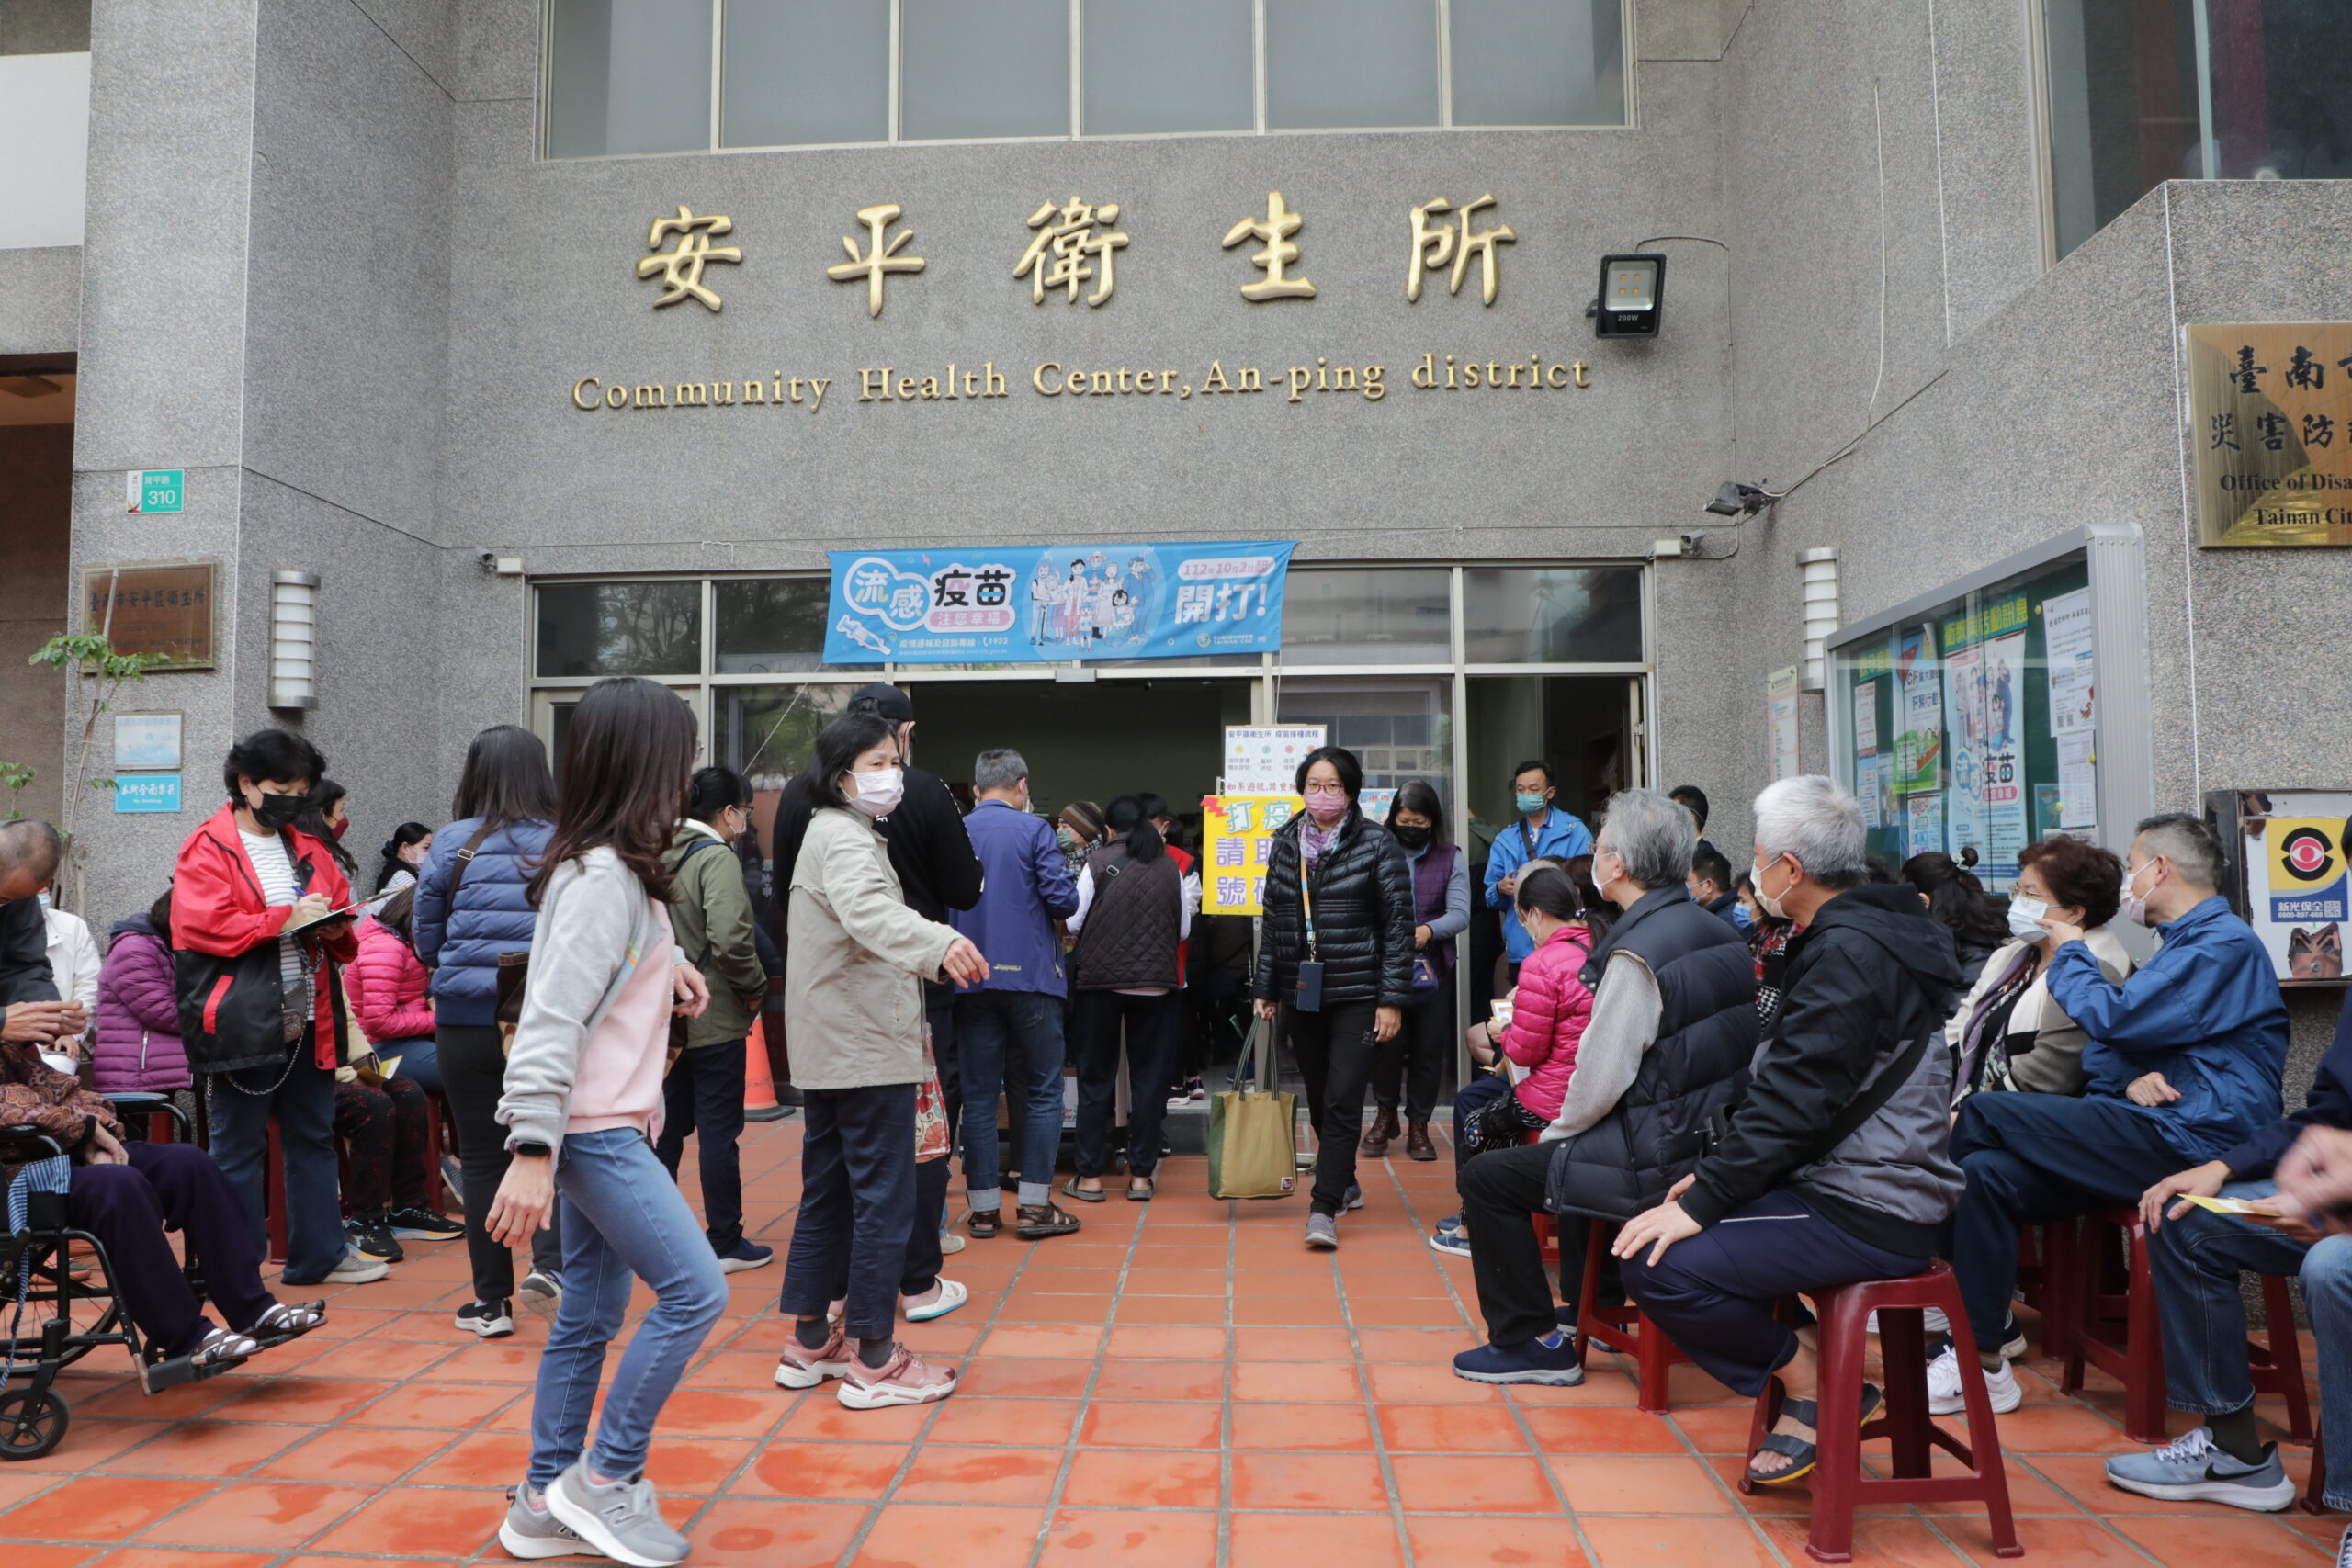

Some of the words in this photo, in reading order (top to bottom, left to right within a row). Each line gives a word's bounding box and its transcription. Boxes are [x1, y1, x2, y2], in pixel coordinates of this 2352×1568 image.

[637, 191, 1518, 318] 安平衛生所
[572, 369, 831, 412] Community
[858, 362, 1008, 400] Health
[1412, 353, 1590, 389] district
[2211, 412, 2352, 451] 災害防
[2221, 474, 2280, 491] Office
[2287, 473, 2307, 490] of
[148, 490, 175, 505] 310
[2256, 508, 2320, 525] Tainan
[854, 569, 922, 619] 流感
[934, 569, 1011, 607] 疫苗
[937, 612, 1001, 626] 注您幸福
[2278, 900, 2323, 911] 新光保全
